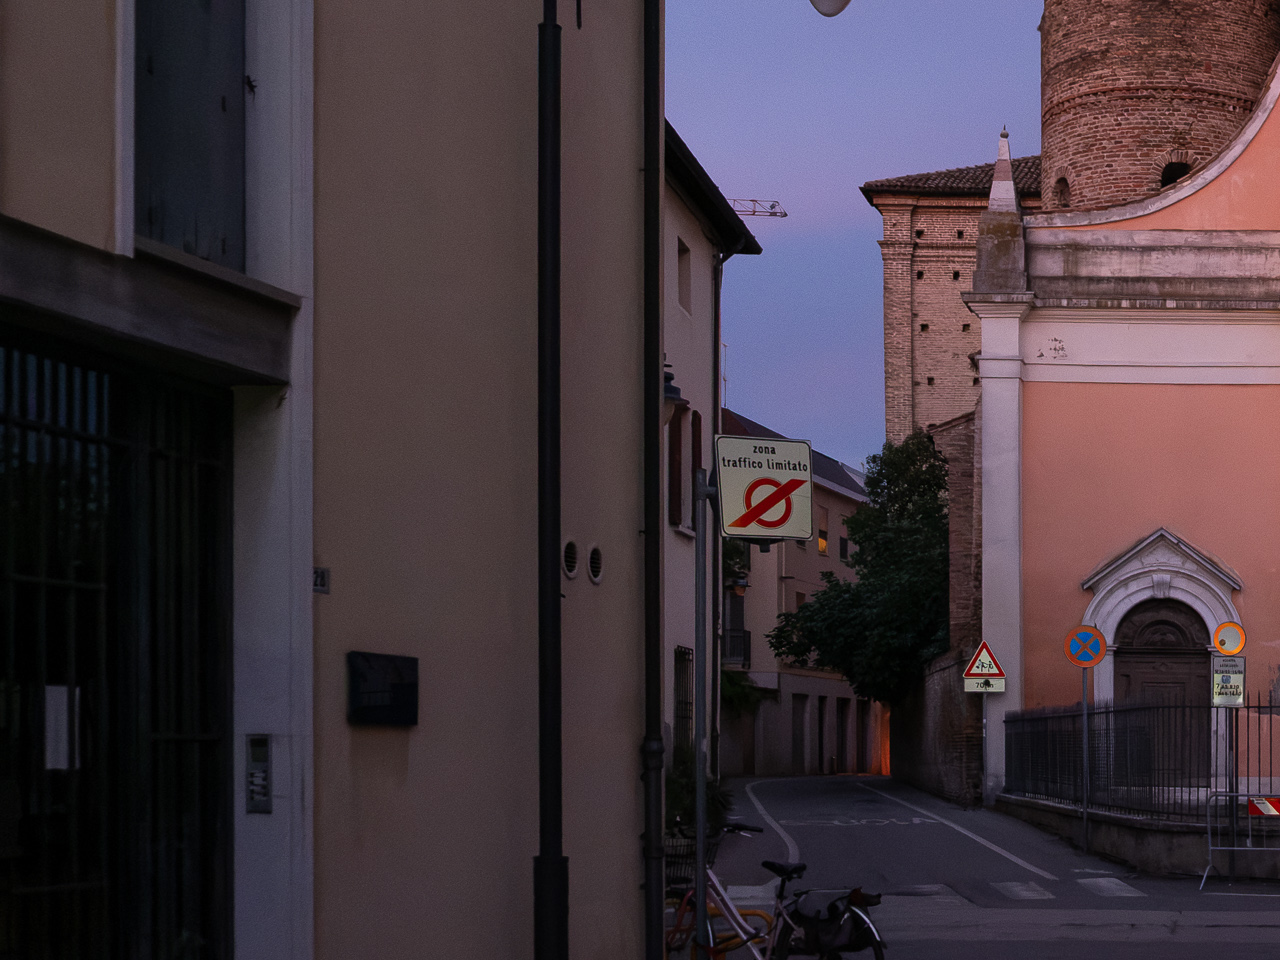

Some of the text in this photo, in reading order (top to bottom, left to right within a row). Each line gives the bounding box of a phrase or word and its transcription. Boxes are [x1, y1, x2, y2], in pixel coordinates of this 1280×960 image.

[753, 445, 776, 454] zona
[722, 457, 808, 471] traffico limitato
